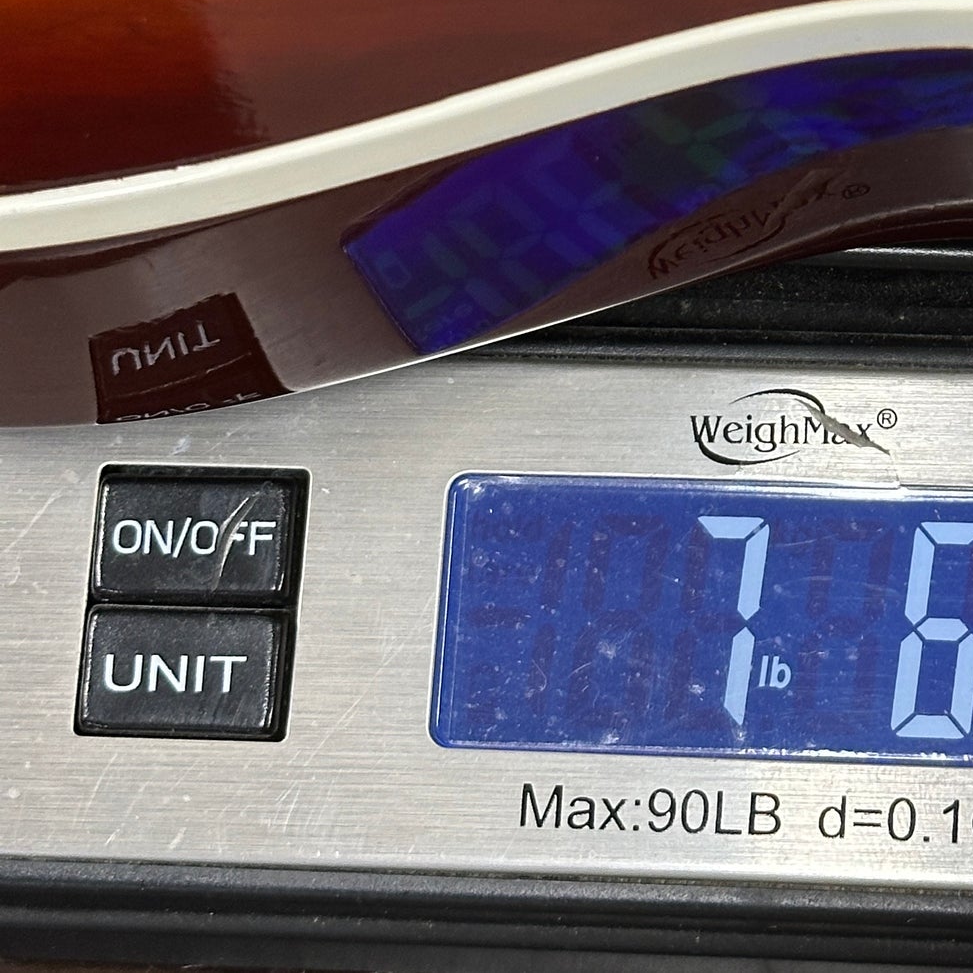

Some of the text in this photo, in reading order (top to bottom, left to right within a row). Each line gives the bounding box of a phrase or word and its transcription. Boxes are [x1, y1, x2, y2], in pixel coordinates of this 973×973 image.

[698, 516, 769, 726] 7
[759, 657, 792, 689] lb
[103, 655, 248, 694] UNIT
[519, 783, 782, 835] Max:90LB
